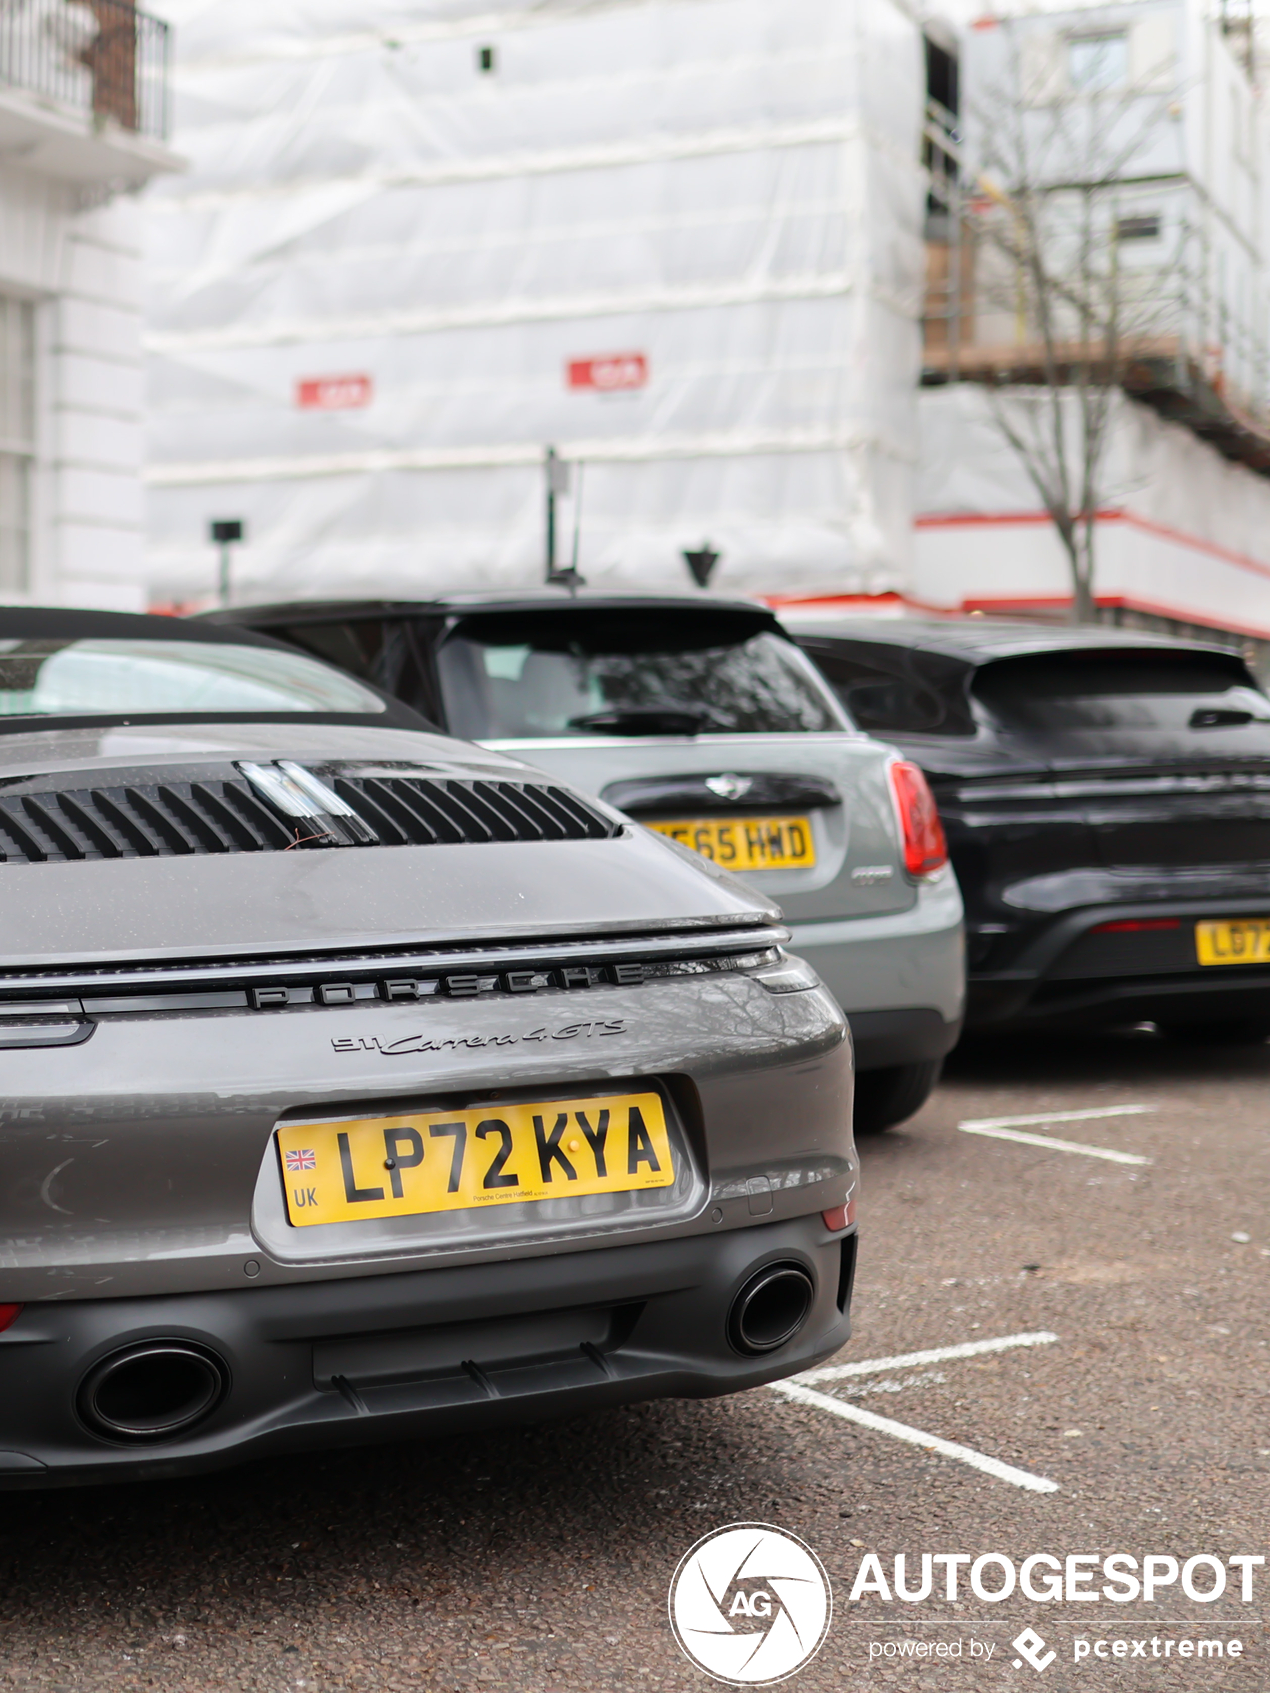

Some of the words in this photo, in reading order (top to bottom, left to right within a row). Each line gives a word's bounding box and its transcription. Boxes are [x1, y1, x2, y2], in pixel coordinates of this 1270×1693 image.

[745, 826, 806, 861] HWD
[251, 963, 644, 1010] PORSCHE
[331, 1032, 386, 1052] 911
[381, 1031, 518, 1055] Carrera
[522, 1027, 547, 1042] 4
[551, 1019, 628, 1040] GTS
[336, 1119, 519, 1203] LP72
[532, 1106, 662, 1183] KYA
[293, 1187, 318, 1208] UK
[473, 1194, 495, 1202] Porsche
[513, 1190, 533, 1198] Hatfield
